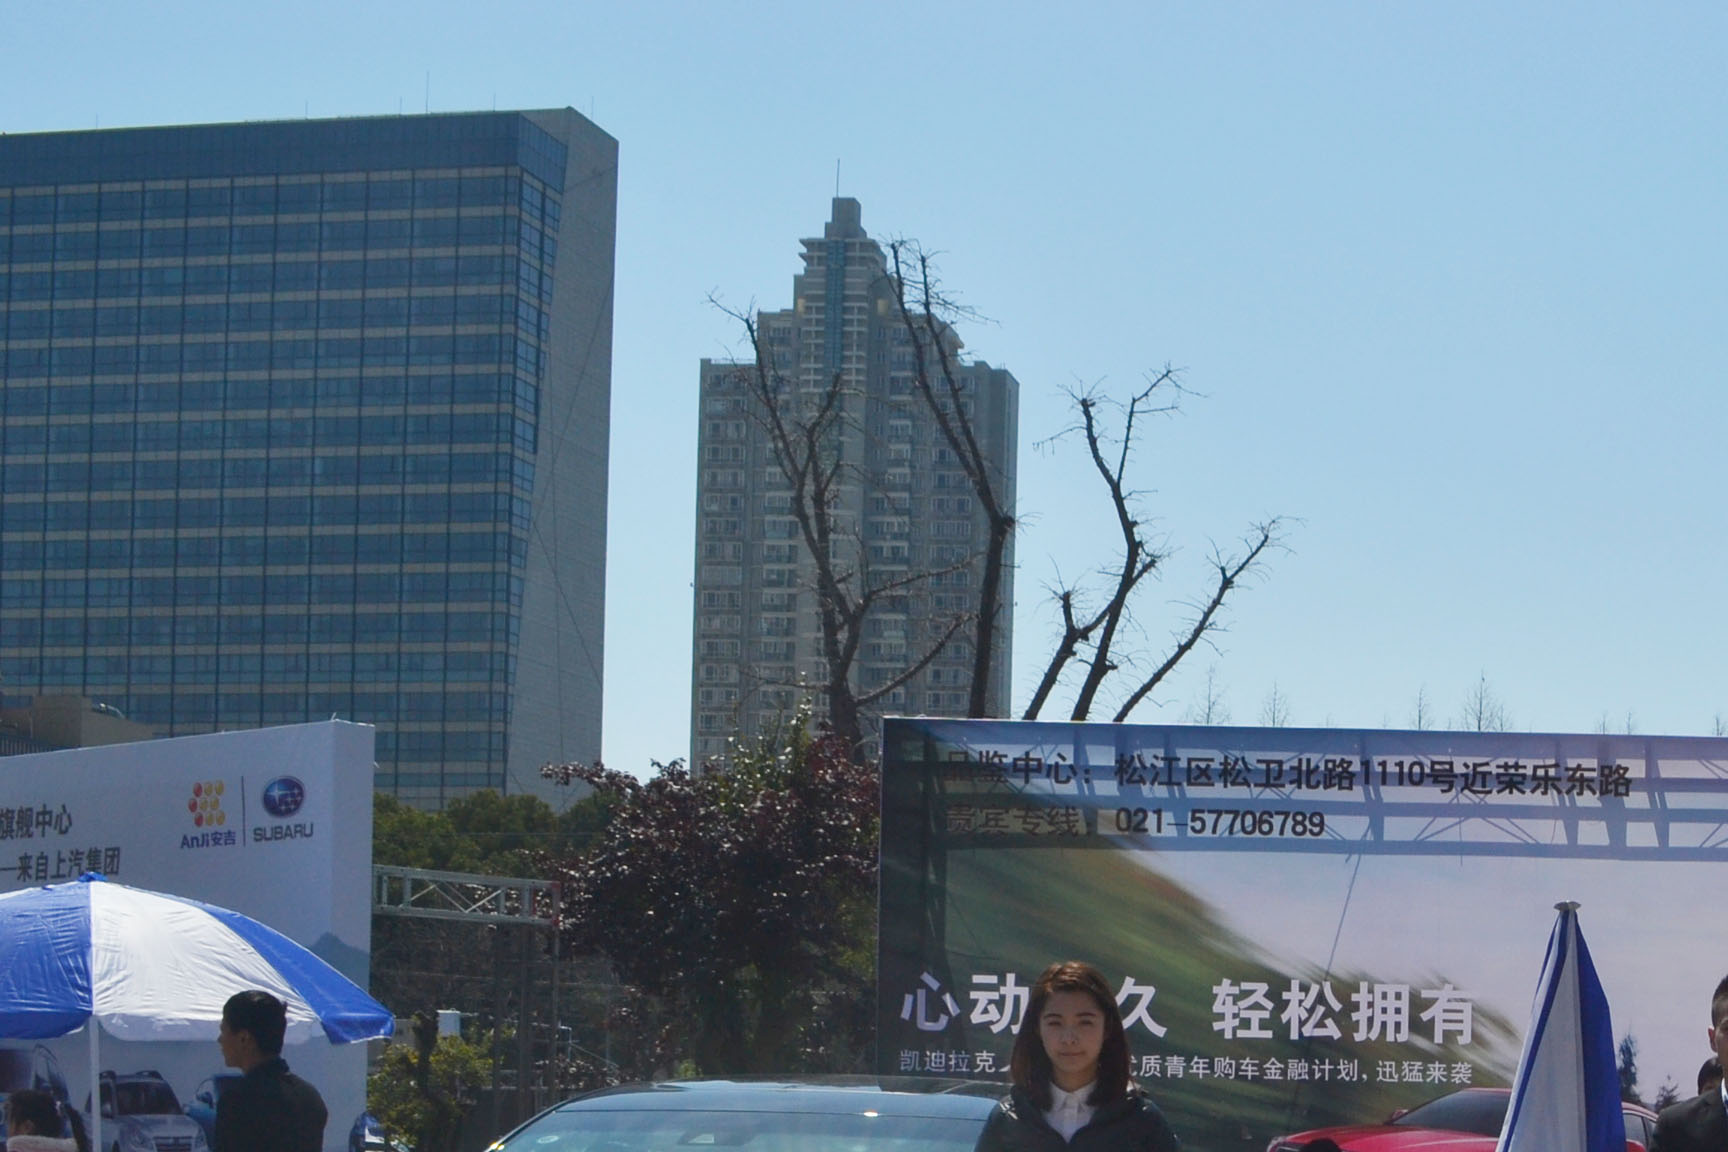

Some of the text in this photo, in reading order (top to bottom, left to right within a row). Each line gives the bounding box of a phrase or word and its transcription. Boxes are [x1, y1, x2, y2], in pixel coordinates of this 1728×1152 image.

[253, 822, 314, 843] SUBARU
[900, 971, 1474, 1045] 心动久 轻松拥有
